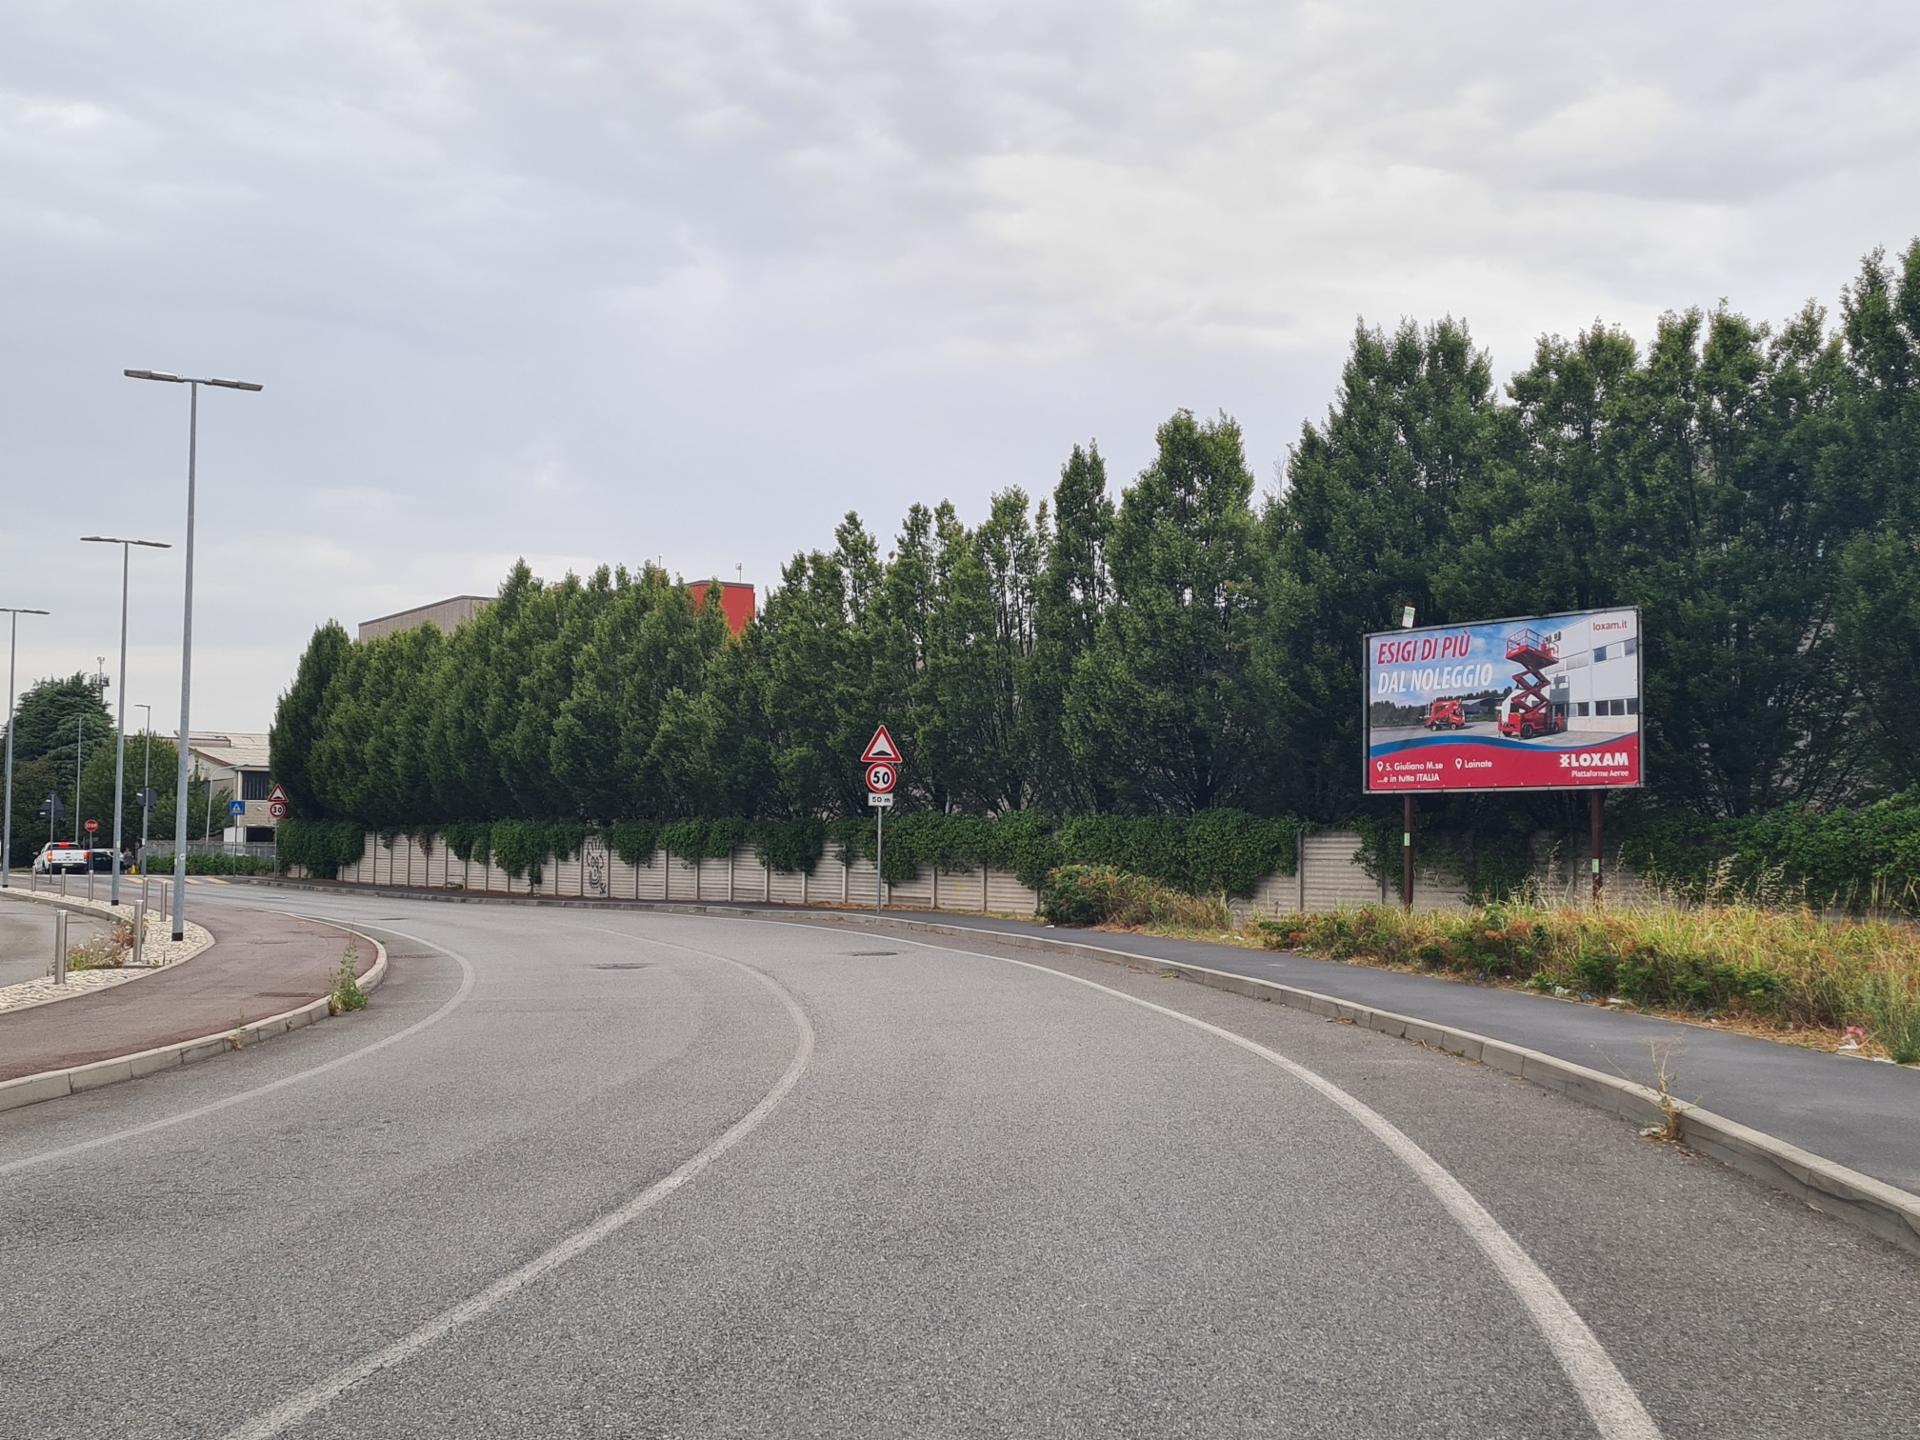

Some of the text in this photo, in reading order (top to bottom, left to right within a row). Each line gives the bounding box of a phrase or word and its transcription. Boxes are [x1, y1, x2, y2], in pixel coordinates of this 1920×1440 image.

[1592, 620, 1627, 631] loxam.it
[1377, 629, 1471, 665] ESIGI DI PIÙ
[1377, 663, 1493, 694] DAL NOLEGGIO
[1464, 760, 1493, 769] Lainate
[1570, 752, 1629, 767] LOXAM
[1385, 763, 1393, 771] S.
[1394, 762, 1424, 771] Giuliano
[873, 771, 890, 785] 50
[1389, 774, 1397, 782] in
[1416, 773, 1440, 782] ITALIA
[1609, 769, 1629, 777] Aeree
